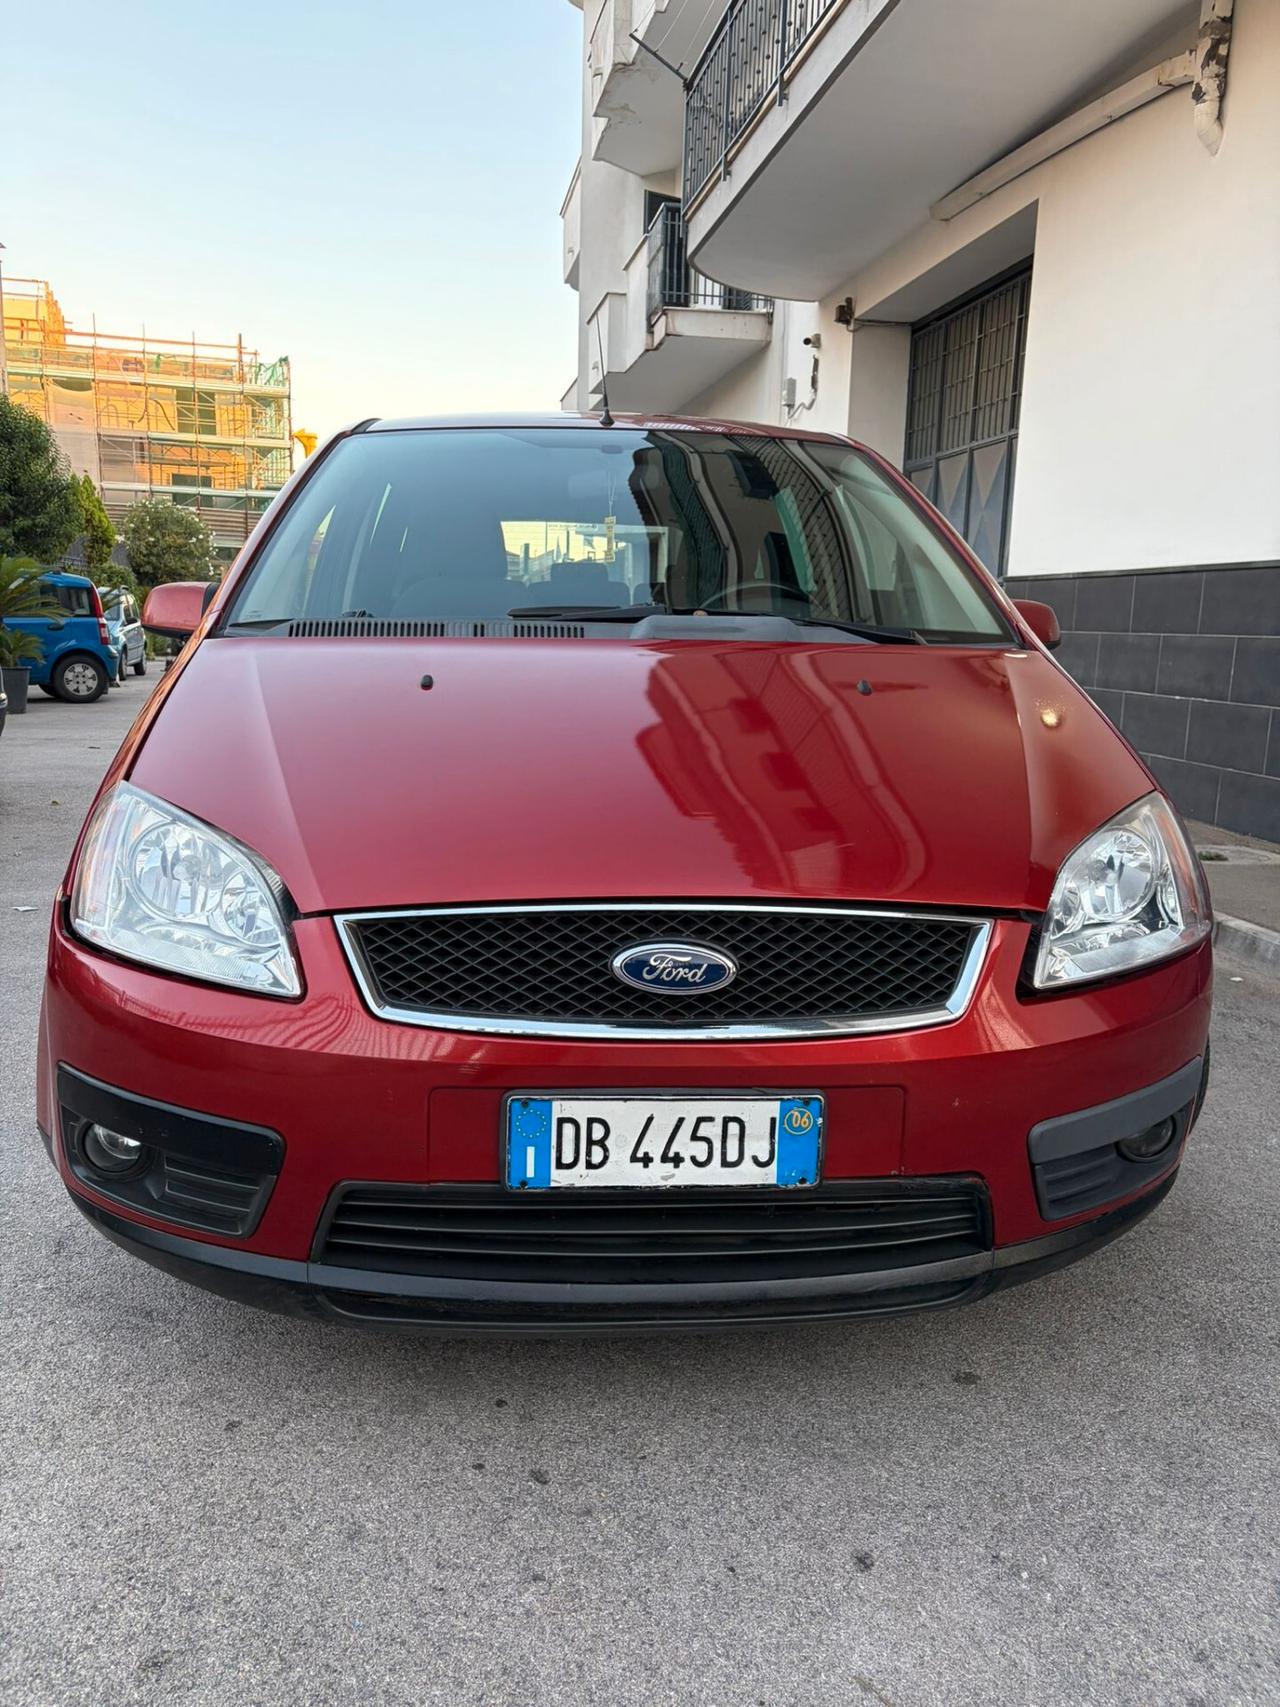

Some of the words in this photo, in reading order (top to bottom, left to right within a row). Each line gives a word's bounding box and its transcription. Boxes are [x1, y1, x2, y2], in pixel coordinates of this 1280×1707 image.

[642, 953, 707, 983] Ford
[791, 1114, 811, 1128] 06
[555, 1116, 611, 1170] DB
[629, 1113, 777, 1169] 445DJ
